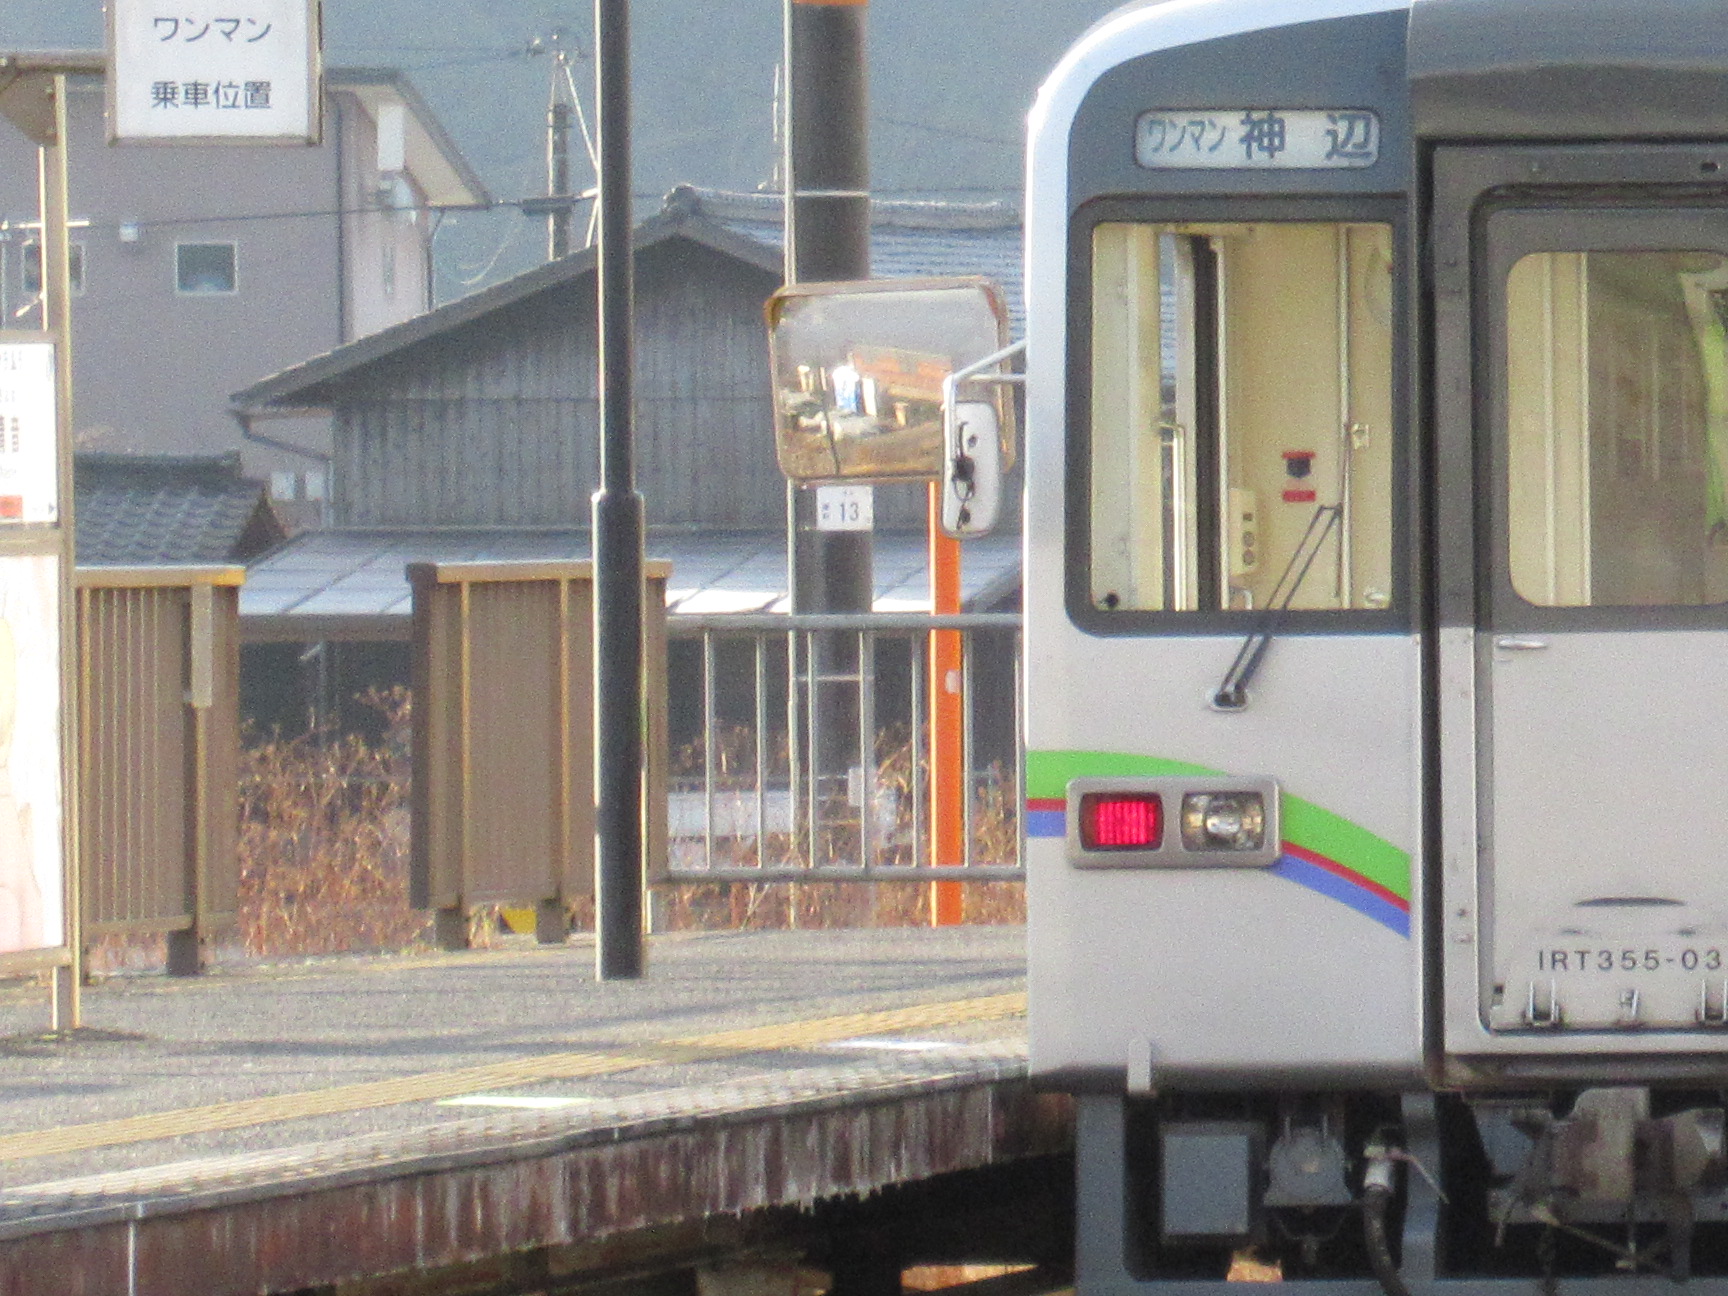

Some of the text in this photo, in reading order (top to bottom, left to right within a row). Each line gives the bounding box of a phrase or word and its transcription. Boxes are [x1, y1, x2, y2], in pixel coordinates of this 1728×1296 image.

[153, 17, 272, 43] ワンマン
[150, 80, 272, 110] 乗車位置
[1148, 118, 1226, 154] ワンマン
[839, 501, 860, 523] 13
[1538, 949, 1722, 971] IRT355-03
